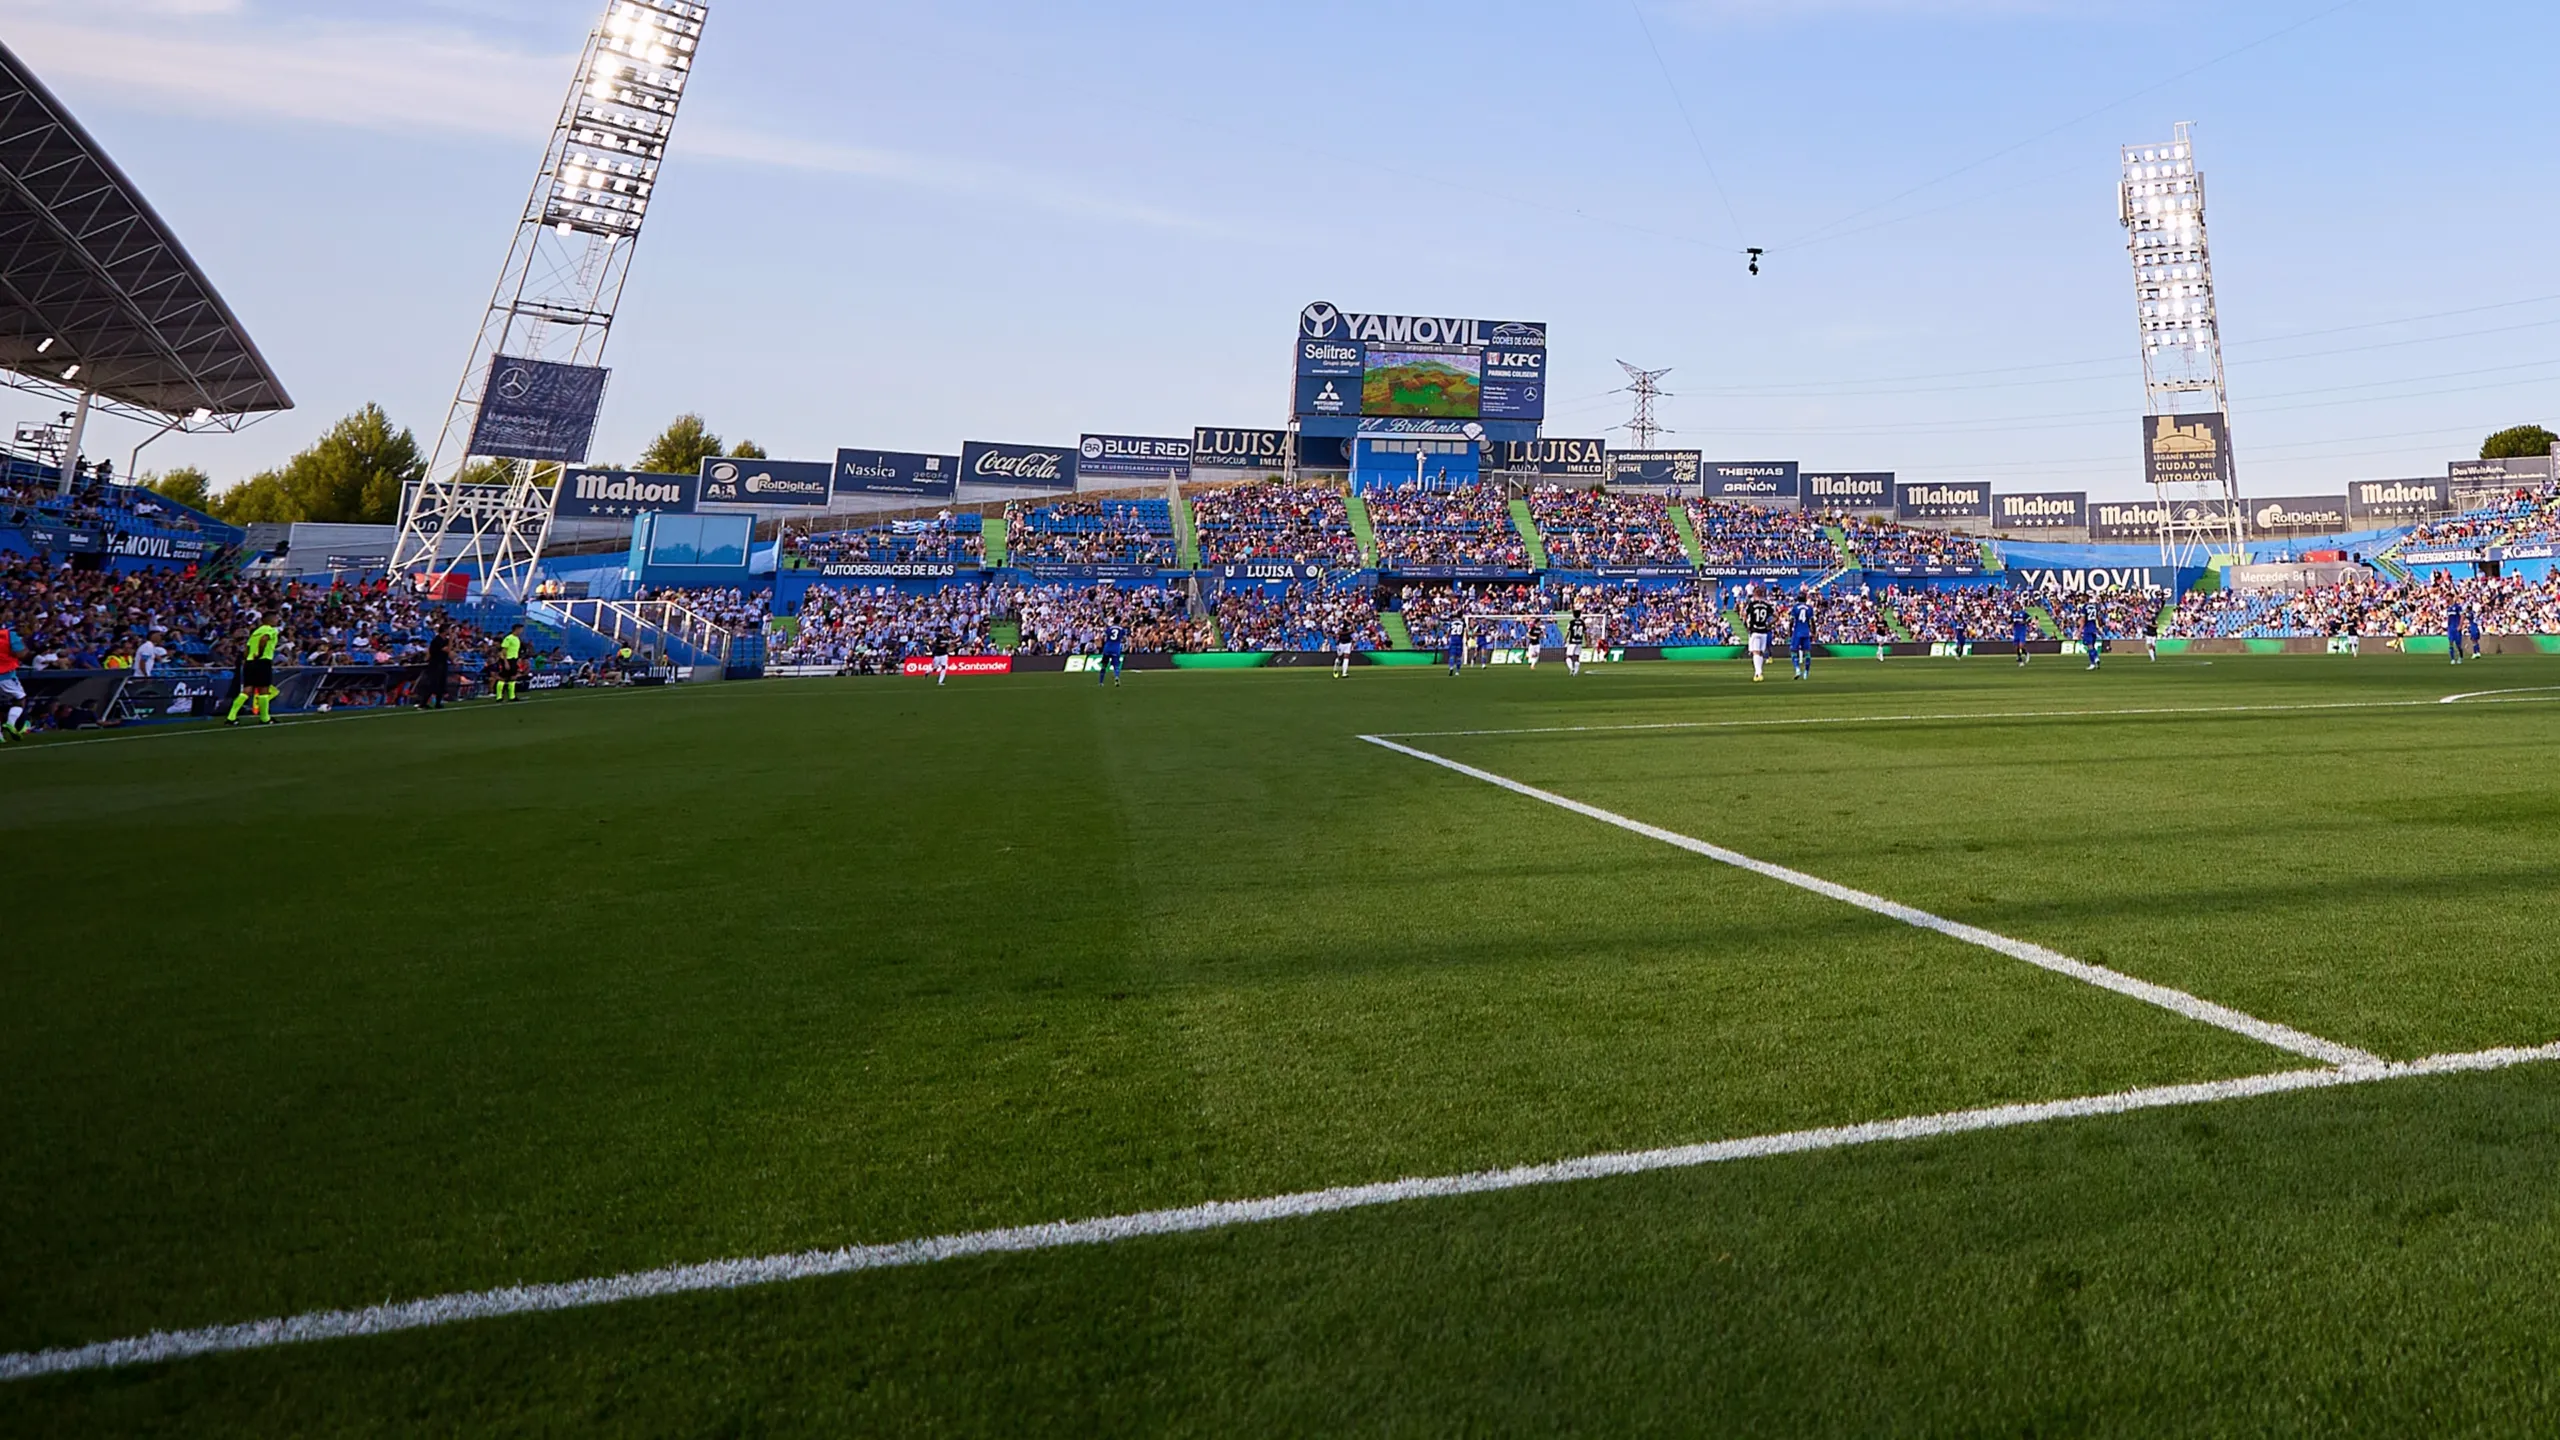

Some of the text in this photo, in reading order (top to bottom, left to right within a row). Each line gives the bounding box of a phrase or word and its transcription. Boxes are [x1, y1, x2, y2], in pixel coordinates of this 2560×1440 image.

[1342, 313, 1490, 346] YAMOVIL
[1492, 336, 1514, 345] COCHES
[1514, 337, 1522, 346] DE
[1305, 344, 1357, 360] Selitrac
[1501, 353, 1541, 368] KFC
[1357, 418, 1460, 434] El Brillante
[1105, 440, 1151, 454] BLUE
[1155, 442, 1190, 456] RED
[1196, 430, 1296, 456] LUJISA
[1508, 440, 1602, 463] LUJISA
[1673, 452, 1698, 460] afición
[844, 456, 896, 478] Nassica
[975, 450, 1063, 478] Coca-Cola
[1567, 465, 1602, 473] IMELCO
[2156, 461, 2196, 470] CIUDAD
[1718, 468, 1784, 476] THERMAS
[2154, 470, 2217, 482] AUTOMÓVIL
[2452, 468, 2467, 476] Das
[575, 474, 680, 502] Mahou
[1724, 481, 1777, 492] GRIÑÓN
[1811, 476, 1883, 495] Mahou
[1908, 485, 1980, 505] Mahou
[2360, 482, 2437, 504] Mahou
[2003, 496, 2076, 516] Mahou
[2456, 551, 2465, 561] DE
[2513, 546, 2553, 557] CaixaBank
[822, 564, 954, 576] AUTODESGUACES DE BLAS
[1246, 565, 1294, 577] LUJISA
[1705, 567, 1736, 576] CIUDAD
[1750, 566, 1799, 576] AUTOMÓVIL
[2020, 568, 2161, 590] YAMOVIL
[2240, 572, 2288, 582] Mercedes
[1754, 608, 1767, 622] 19
[1799, 609, 1806, 623] 4
[1111, 629, 1119, 640] 3
[1451, 624, 1462, 635] 20
[1572, 626, 1583, 636] 14
[958, 661, 1008, 671] Santander
